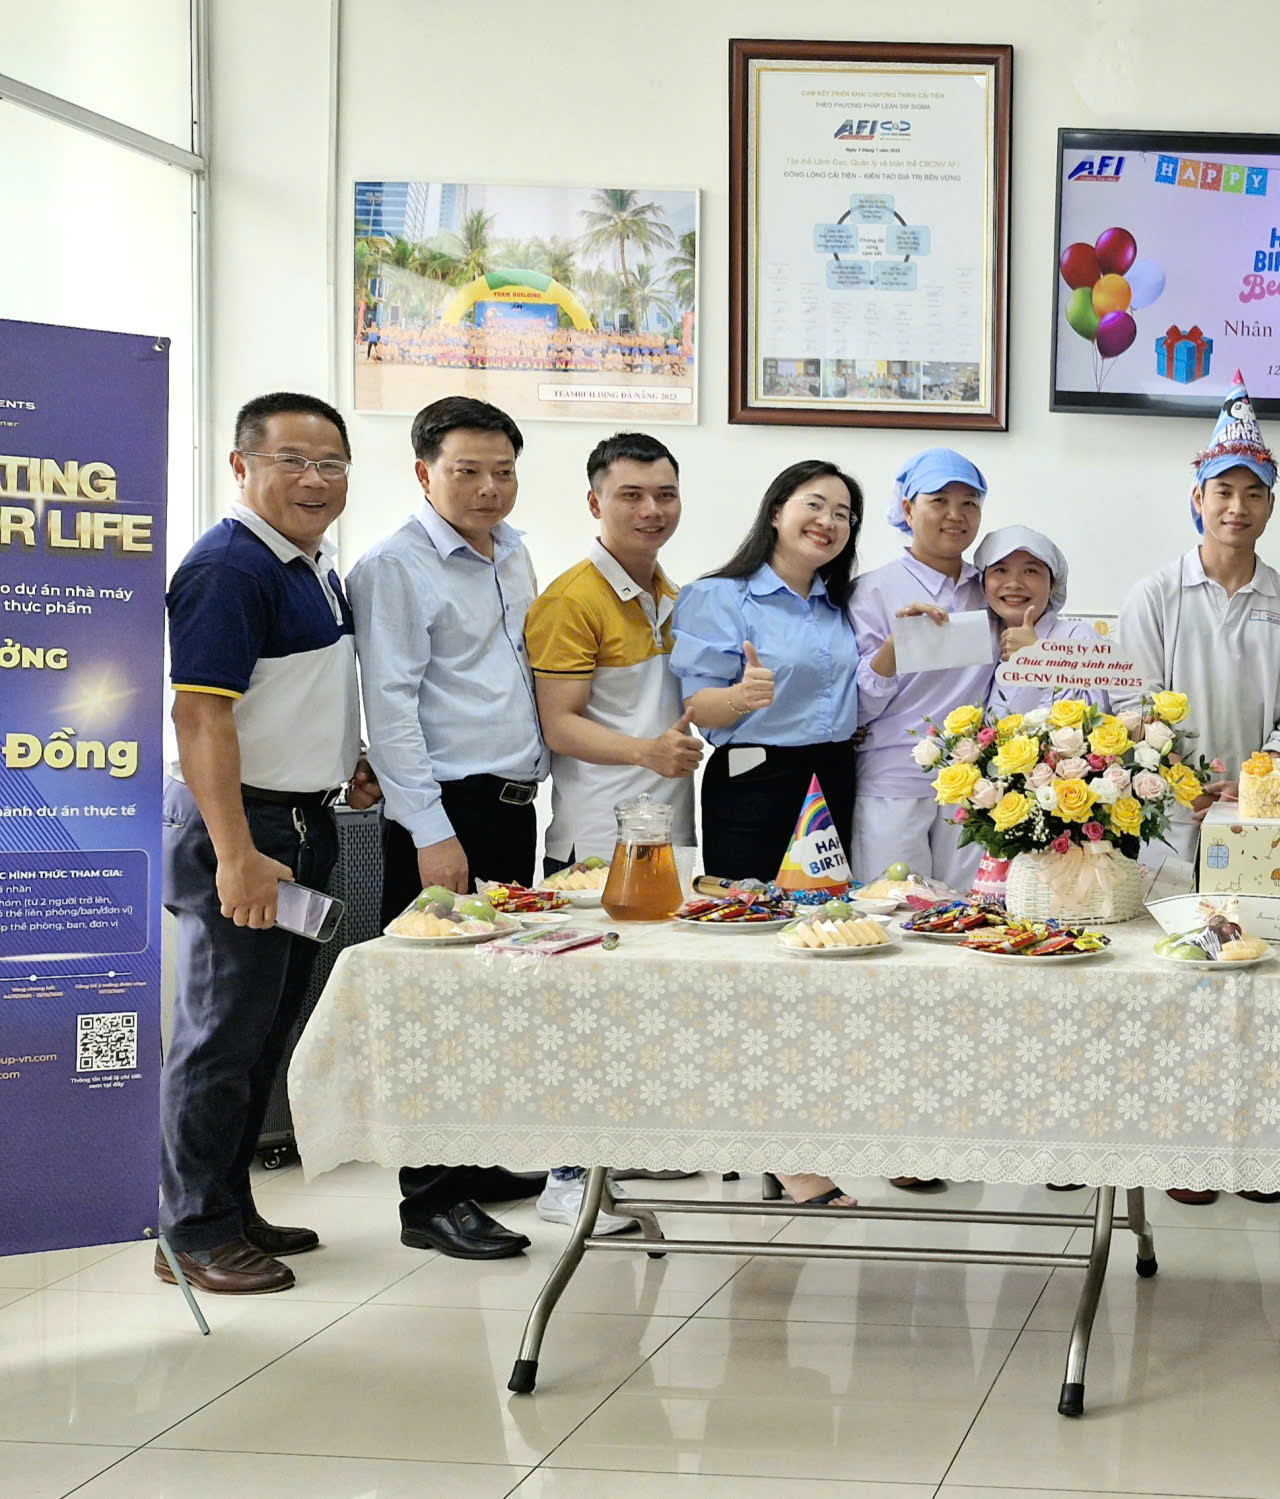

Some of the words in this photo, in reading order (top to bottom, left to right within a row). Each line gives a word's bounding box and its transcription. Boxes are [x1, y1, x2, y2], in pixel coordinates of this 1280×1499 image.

[834, 119, 878, 139] AFI
[1068, 156, 1125, 180] AFI
[1160, 162, 1263, 190] HAPPY
[1224, 320, 1273, 338] Nhân
[0, 455, 117, 500] TING
[0, 505, 36, 546] R
[48, 508, 153, 553] LIFE
[14, 582, 38, 598] dự
[40, 584, 61, 596] án
[65, 585, 95, 598] nhà
[99, 587, 133, 602] máy
[3, 599, 42, 615] thực
[45, 600, 92, 615] phẩm
[0, 638, 68, 670] ỞNG
[1041, 641, 1074, 655] Công
[1077, 642, 1089, 656] ty
[1091, 644, 1112, 655] AFI
[1016, 656, 1044, 667] Chúc
[1045, 658, 1079, 671] mừng
[1081, 660, 1105, 670] sinh
[1107, 661, 1134, 674] nhật
[1002, 671, 1053, 683] CB-CNV
[1056, 673, 1092, 687] tháng
[1094, 676, 1143, 687] 09/2025
[2, 727, 139, 778] Đồng
[36, 805, 57, 819] dự
[60, 804, 80, 817] án
[84, 804, 118, 820] thực
[121, 802, 137, 817] tế
[9, 869, 36, 880] HÌNH
[38, 867, 69, 879] THỨC
[69, 868, 99, 879] THAM
[102, 868, 124, 878] GIA:
[5, 884, 33, 894] nhân
[40, 897, 47, 906] 2
